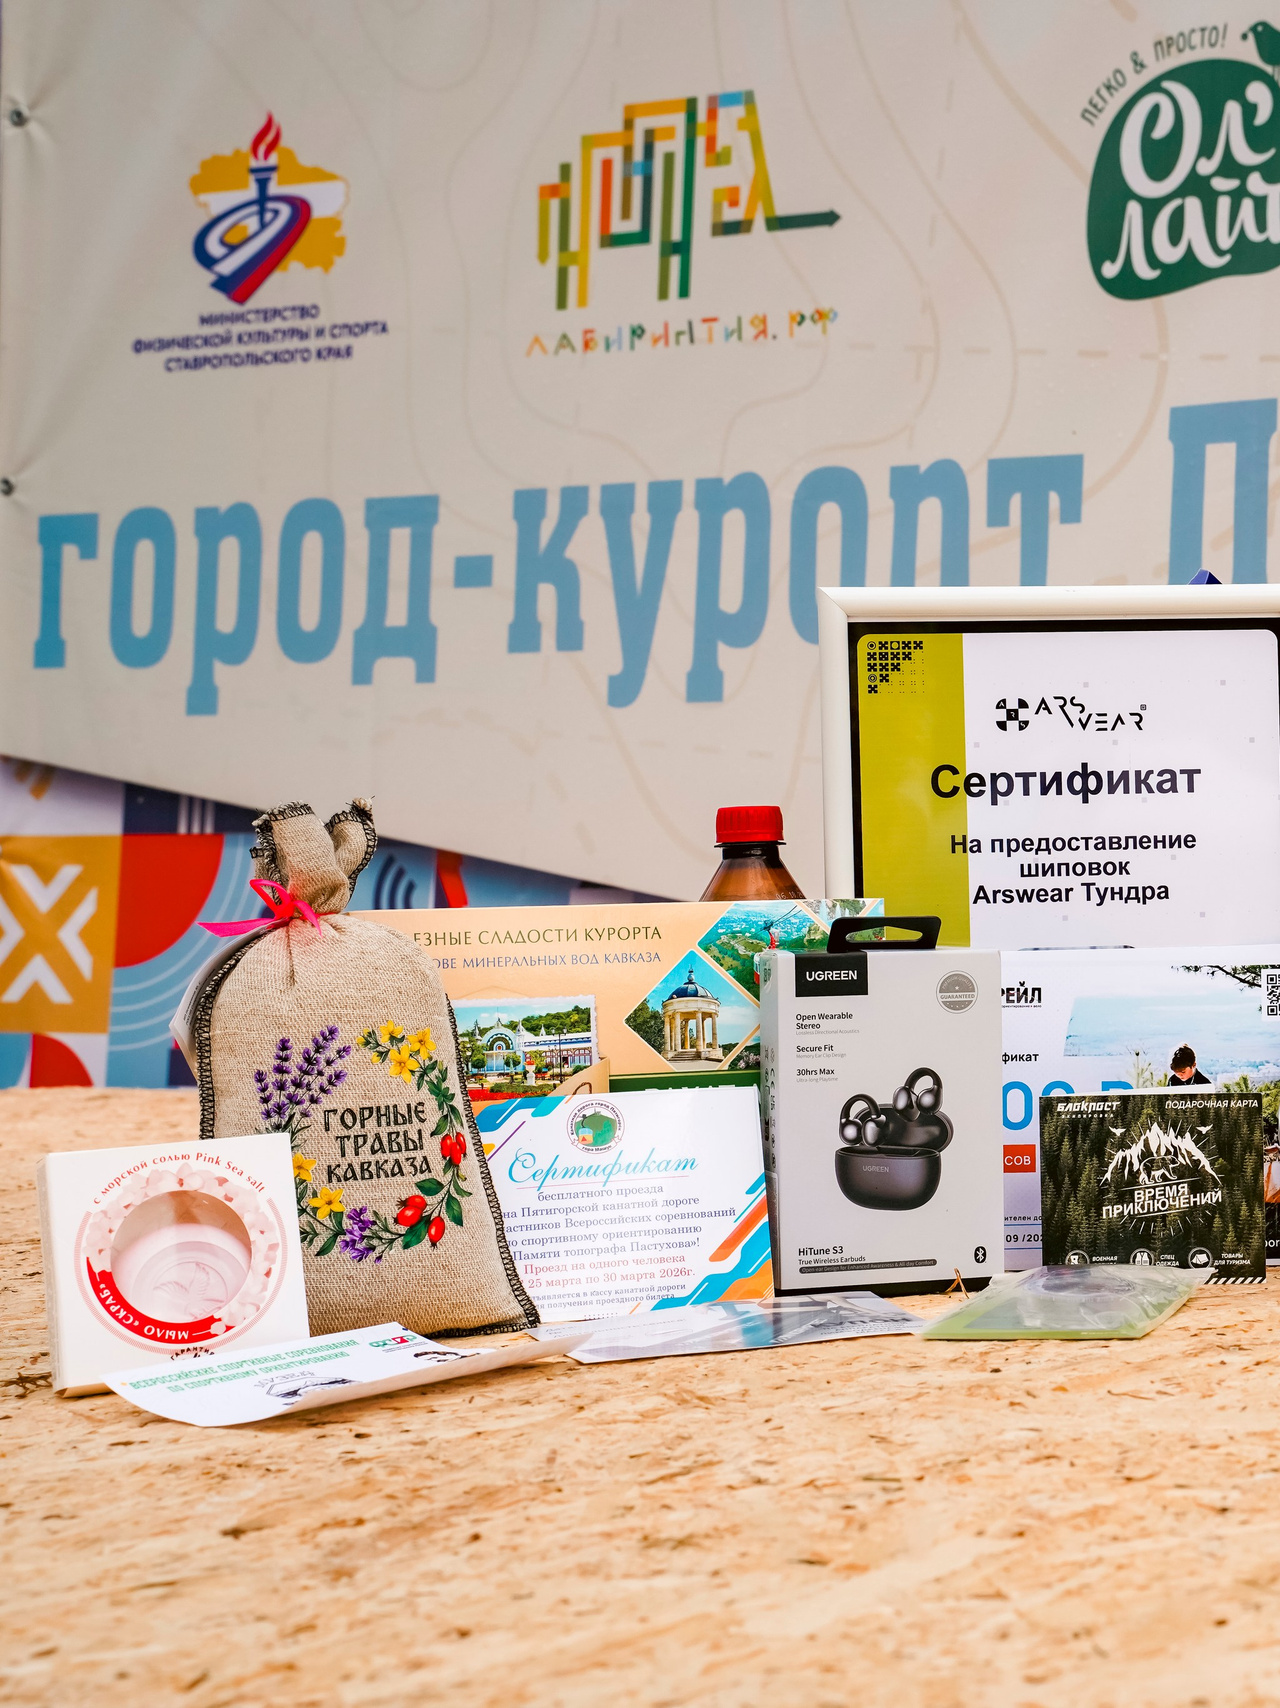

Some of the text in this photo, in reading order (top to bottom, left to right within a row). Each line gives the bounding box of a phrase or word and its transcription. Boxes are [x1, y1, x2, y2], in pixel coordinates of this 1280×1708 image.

[1153, 23, 1228, 61] ПРОСТО!
[199, 304, 320, 326] МИНИСТЕРСТВО
[132, 321, 389, 354] ФИЗИЧЕСКОЙ КУЛЬТУРЫ СПОРТА
[164, 345, 354, 373] СТАВРОПОЛЬСКОГО КРАЯ
[930, 762, 1202, 806] Сертификат
[950, 832, 1197, 857] На предоставление
[1019, 858, 1131, 878] шиповок
[972, 881, 1170, 908] Arswear Тундра
[477, 926, 662, 948] СЛАДОСТИ КУРОРТА
[462, 951, 662, 969] МИНЕРАЛЬНЫХ ВОД КАВКАЗА
[806, 970, 857, 982] UGREEN
[795, 1011, 853, 1022] Open Wearable
[796, 1022, 821, 1030] Stereo
[796, 1045, 822, 1053] Secure
[796, 1067, 835, 1077] 30hrs Max
[1165, 1099, 1228, 1110] ПОДАРОЧНАЯ
[1230, 1099, 1259, 1108] КАРТА
[324, 1102, 427, 1132] ГОРНЫЕ
[335, 1129, 424, 1158] ТРАВЫ
[101, 1152, 266, 1197] морской солью Pink Sea salt
[327, 1155, 432, 1183] КАВКАЗА
[508, 1147, 699, 1191] Сертификат
[862, 1165, 890, 1173] UGREEN
[538, 1184, 664, 1202] бесплатного проезда
[1102, 1187, 1222, 1218] ПРИКЛЮЧЕНИЙ
[1134, 1183, 1188, 1202] ВРЕМЯ
[521, 1197, 700, 1218] Пятигорской канатной дороге
[565, 1207, 737, 1229] Всероссийских соревнований
[521, 1224, 702, 1248] спортивному ориентированию
[564, 1243, 627, 1259] топографа
[798, 1247, 831, 1257] HiTune
[813, 1256, 839, 1265] Wireless
[524, 1254, 686, 1276] Проезд одного человека
[527, 1267, 696, 1289] 25 марта 30 марта 2026г.
[98, 1283, 190, 1340] МЫЛО «СКРАБ»
[129, 1367, 218, 1391] ВСЕРОССИЙСКИЕ
[218, 1351, 286, 1375] СПОРТИВНЫЕ
[286, 1339, 360, 1362] СОРЕВНОВАНИЯ
[184, 1368, 260, 1393] СПОРТИВНОМУ
[262, 1351, 349, 1375] ОРИЕНТИРОВАНИЮ
